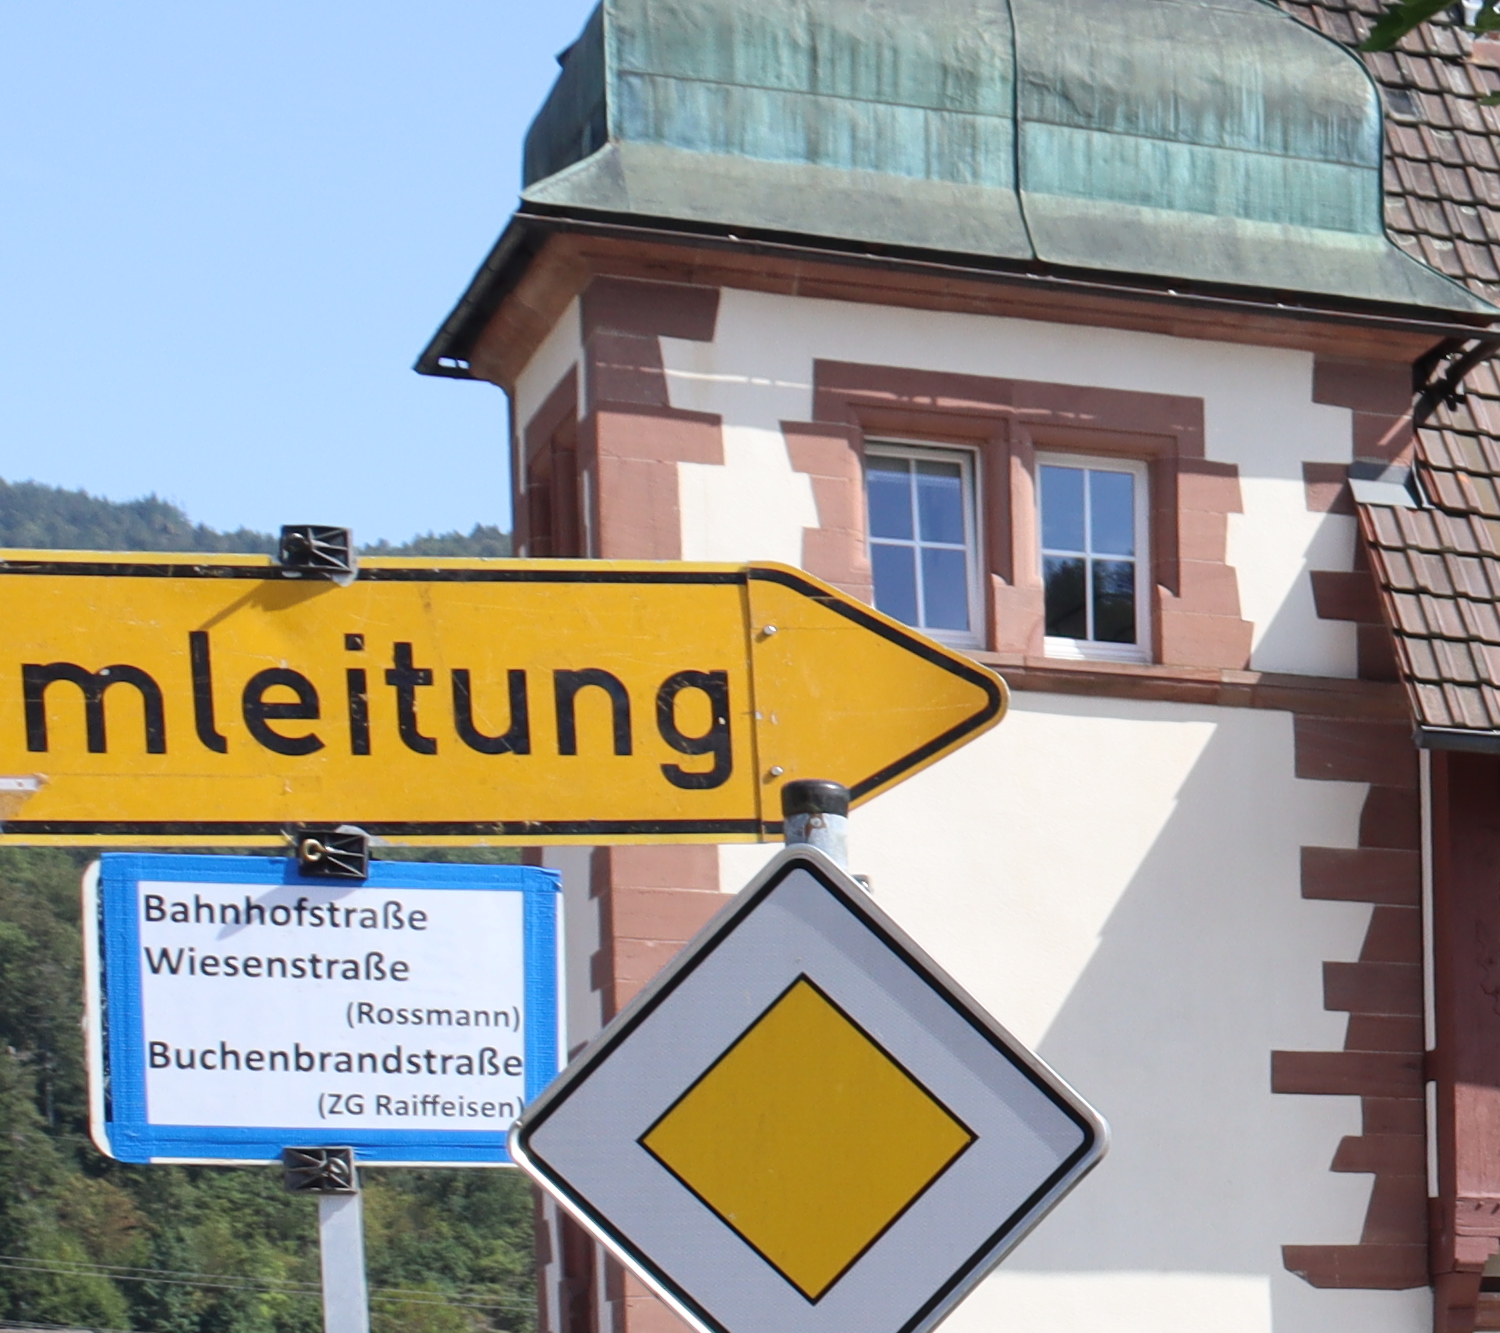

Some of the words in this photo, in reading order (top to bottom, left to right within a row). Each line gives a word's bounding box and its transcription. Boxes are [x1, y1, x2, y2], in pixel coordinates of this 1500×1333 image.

[143, 893, 428, 931] Bahnhofstraße
[144, 946, 410, 981] Wiesenstraße
[346, 1001, 521, 1032] (Rossmann)
[148, 1040, 523, 1076] Buchenbrandstraße
[318, 1093, 365, 1119] (ZG
[375, 1094, 525, 1119] Raiffeisen)
